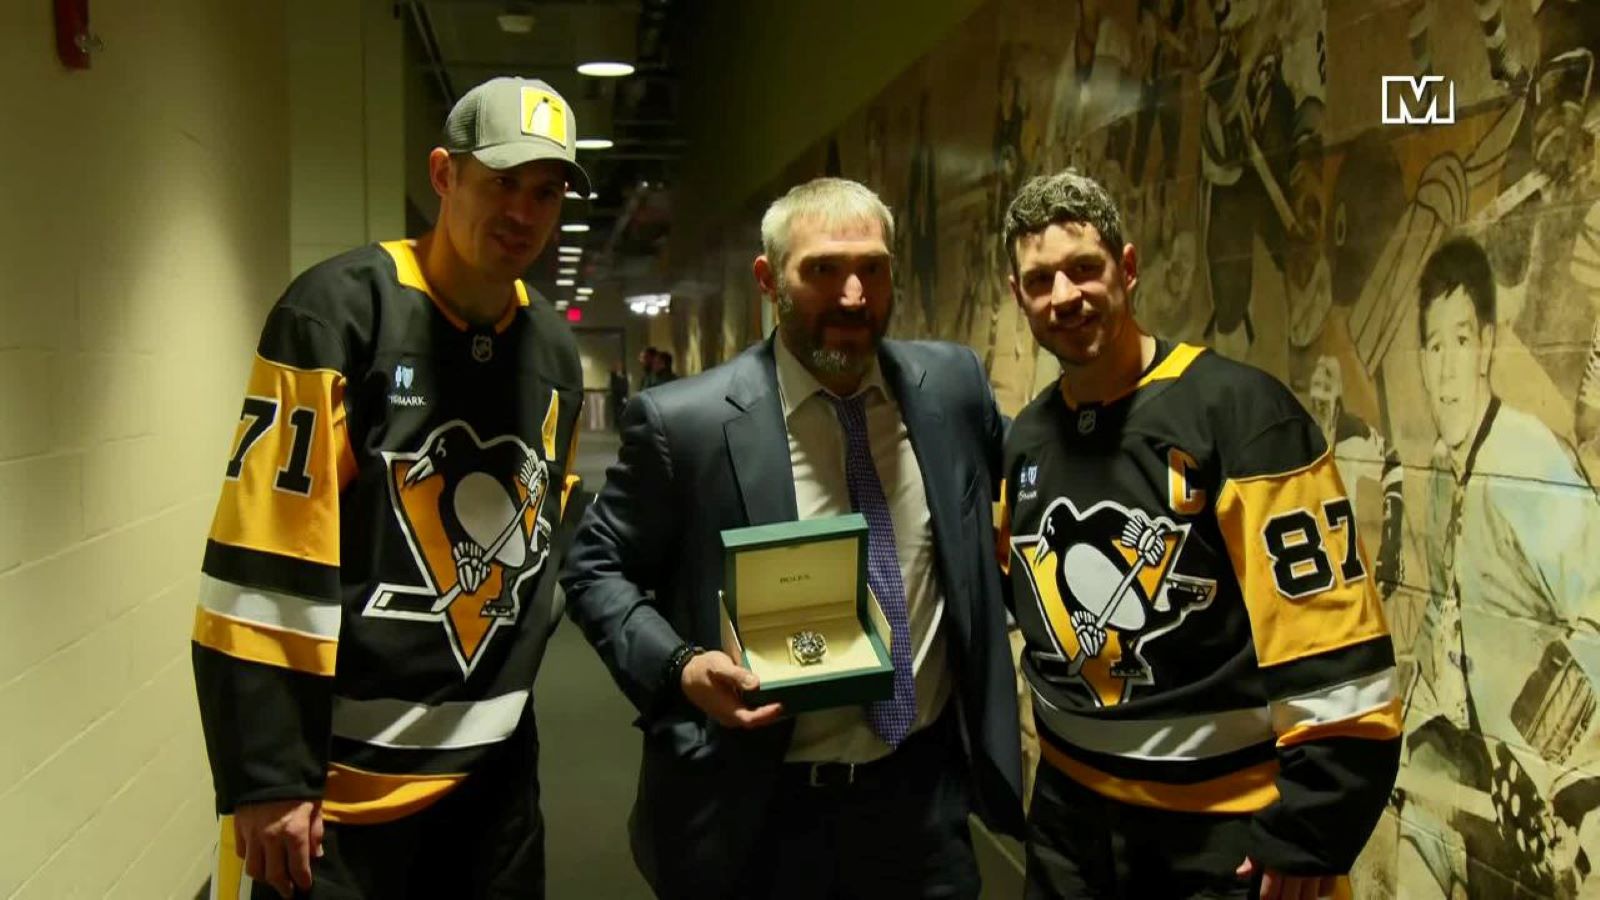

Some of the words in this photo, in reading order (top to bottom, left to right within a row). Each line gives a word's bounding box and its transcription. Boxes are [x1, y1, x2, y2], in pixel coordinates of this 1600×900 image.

[225, 396, 317, 498] 71
[1167, 447, 1207, 516] C
[1260, 496, 1368, 600] 87
